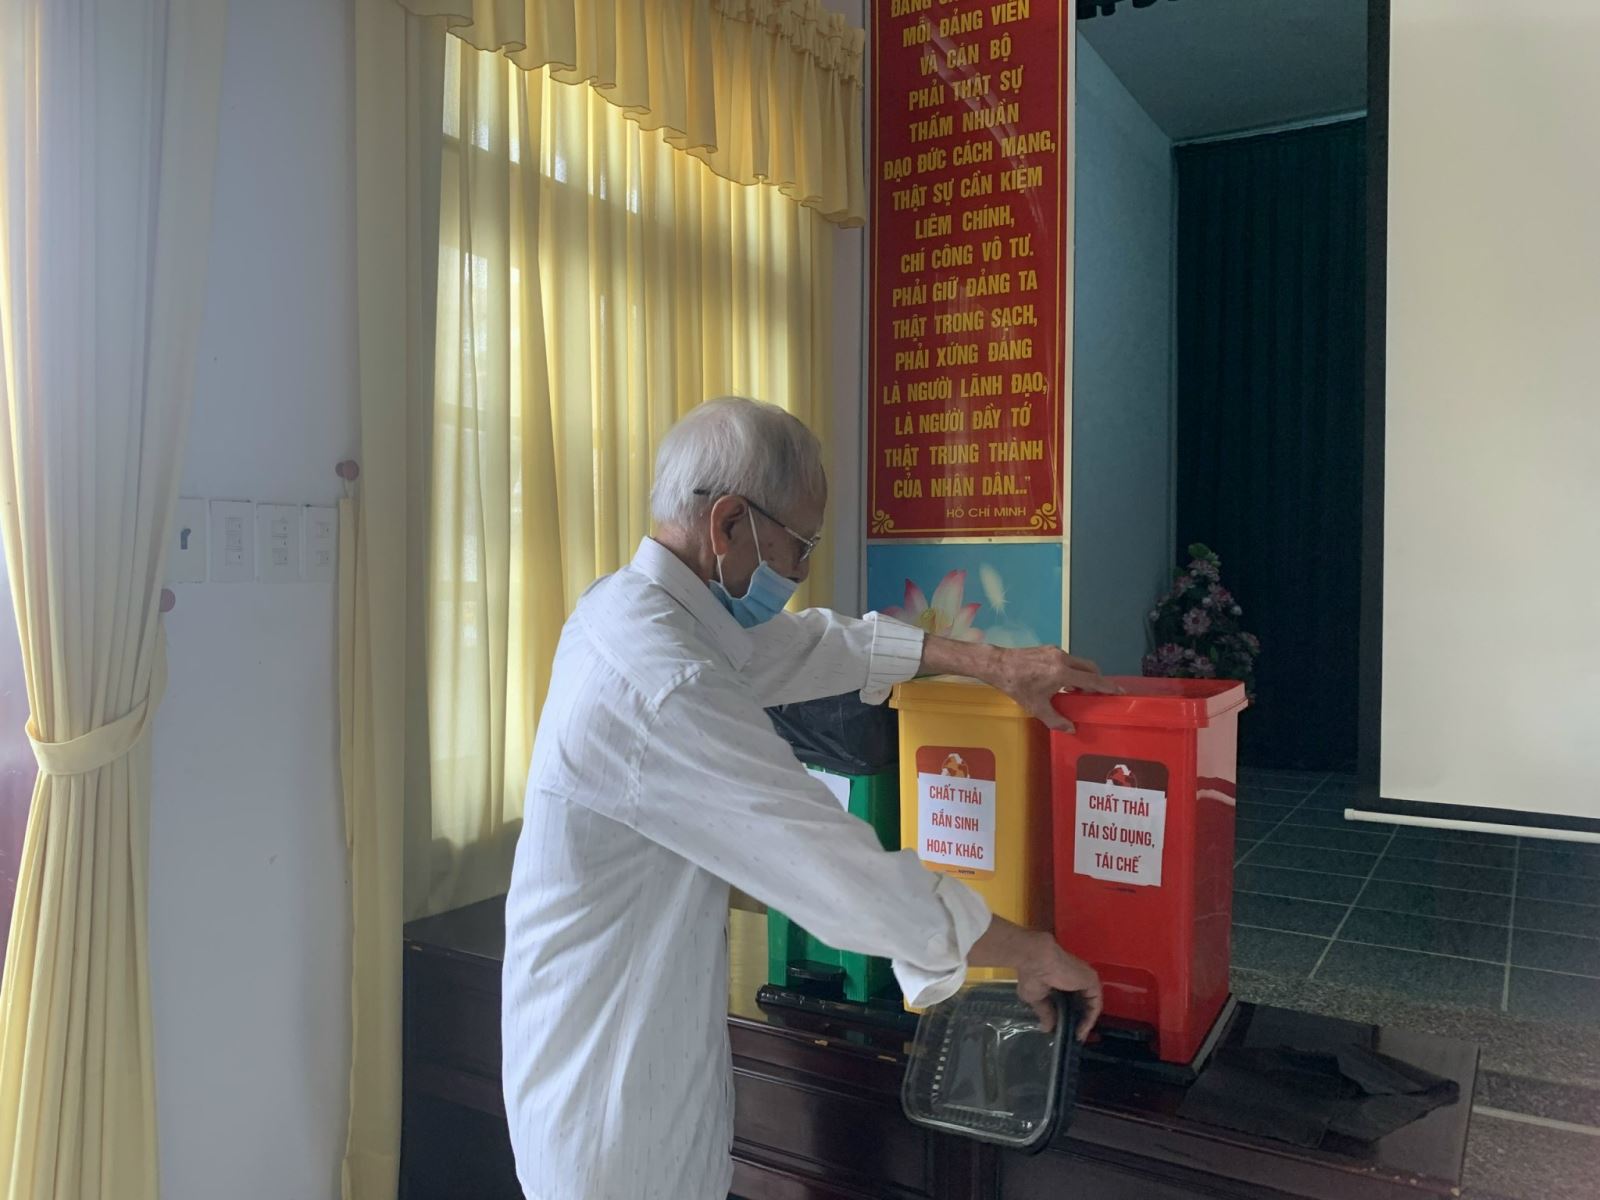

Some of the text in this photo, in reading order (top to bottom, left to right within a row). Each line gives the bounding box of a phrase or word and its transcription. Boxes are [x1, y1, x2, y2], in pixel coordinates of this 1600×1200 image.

[939, 8, 983, 38] ĐẢNG
[920, 32, 1011, 76] VÀ CÁN BỘ
[909, 65, 1023, 111] PHẢI THẬT SỰ
[909, 99, 1019, 143] THẤM NHUẦN
[884, 130, 1056, 182] ĐẠO ĐỨC CÁCH MẠNG,
[892, 184, 927, 212] THẬT
[933, 178, 954, 206] SỰ
[961, 170, 992, 199] CẦN
[915, 204, 1015, 240] LIÊM CHÍNH,
[901, 233, 1034, 273] CHÍ CÔNG VÔ TƯ.
[892, 268, 1037, 307] PHẢI GIỮ ĐẢNG TA
[892, 304, 1038, 342] THẬT TRONG SẠCH,
[895, 335, 1032, 372] PHẢI XỨNG ĐÁNG
[883, 372, 1047, 405] LÀ NGƯỜI LÃNH ĐẠO,
[895, 401, 1032, 435] LÀ NGƯỜI ĐẦY TỚ
[884, 437, 1043, 471] THẬT TRUNG THÀNH
[893, 473, 922, 498] CỦA
[931, 473, 974, 497] NHÂN
[968, 505, 990, 518] CHÍ
[994, 506, 1026, 517] MINH
[929, 783, 982, 805] CHẤT THẢI
[1089, 794, 1149, 817] CHẤT THẢI
[932, 809, 979, 832] RẮN SINH
[1081, 821, 1155, 848] TÁI SỬ DỤNG,
[927, 839, 984, 860] HOẠT KHÁC
[1095, 852, 1141, 874] TÁI CHẾ
